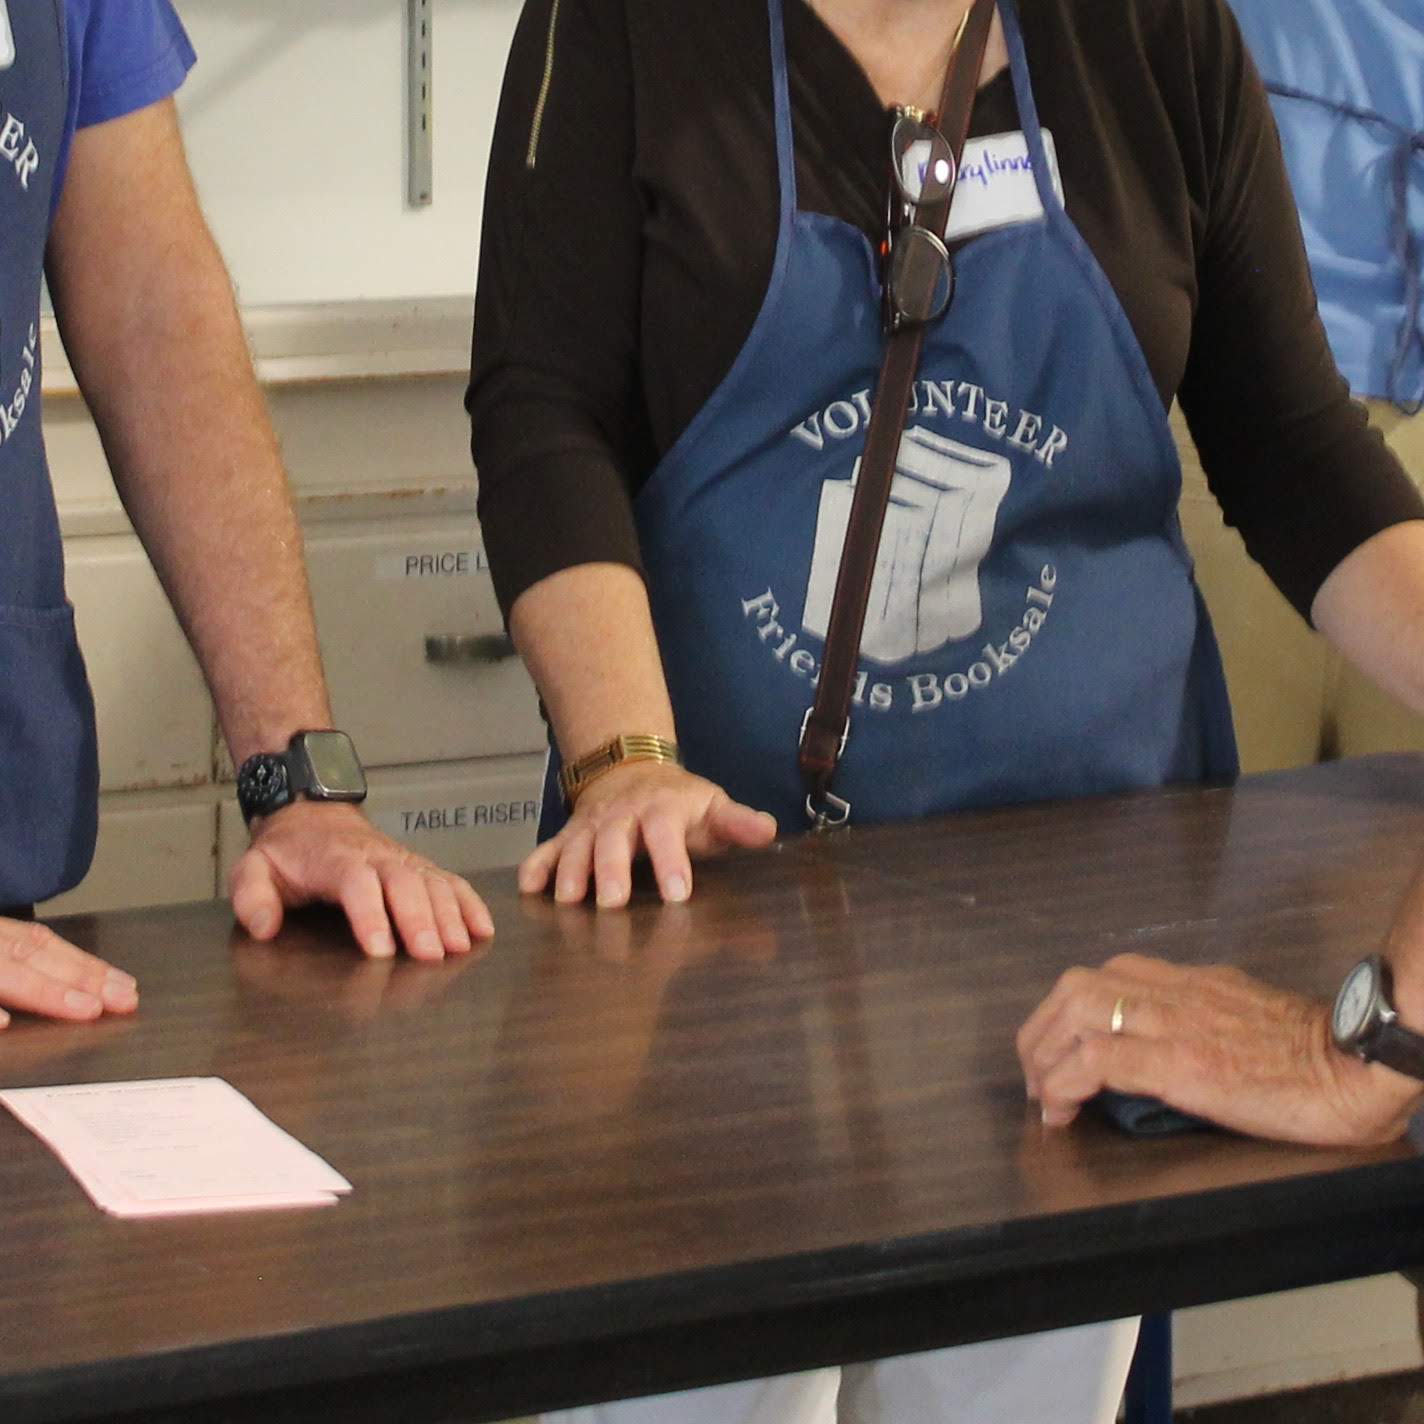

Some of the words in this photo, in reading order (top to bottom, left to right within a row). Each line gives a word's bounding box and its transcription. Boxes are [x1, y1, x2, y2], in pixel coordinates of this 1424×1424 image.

[405, 552, 469, 576] PRICE
[740, 586, 894, 713] Frieds
[907, 562, 1059, 716] Booksale
[401, 808, 466, 832] TABLE
[476, 800, 537, 826] RISER
